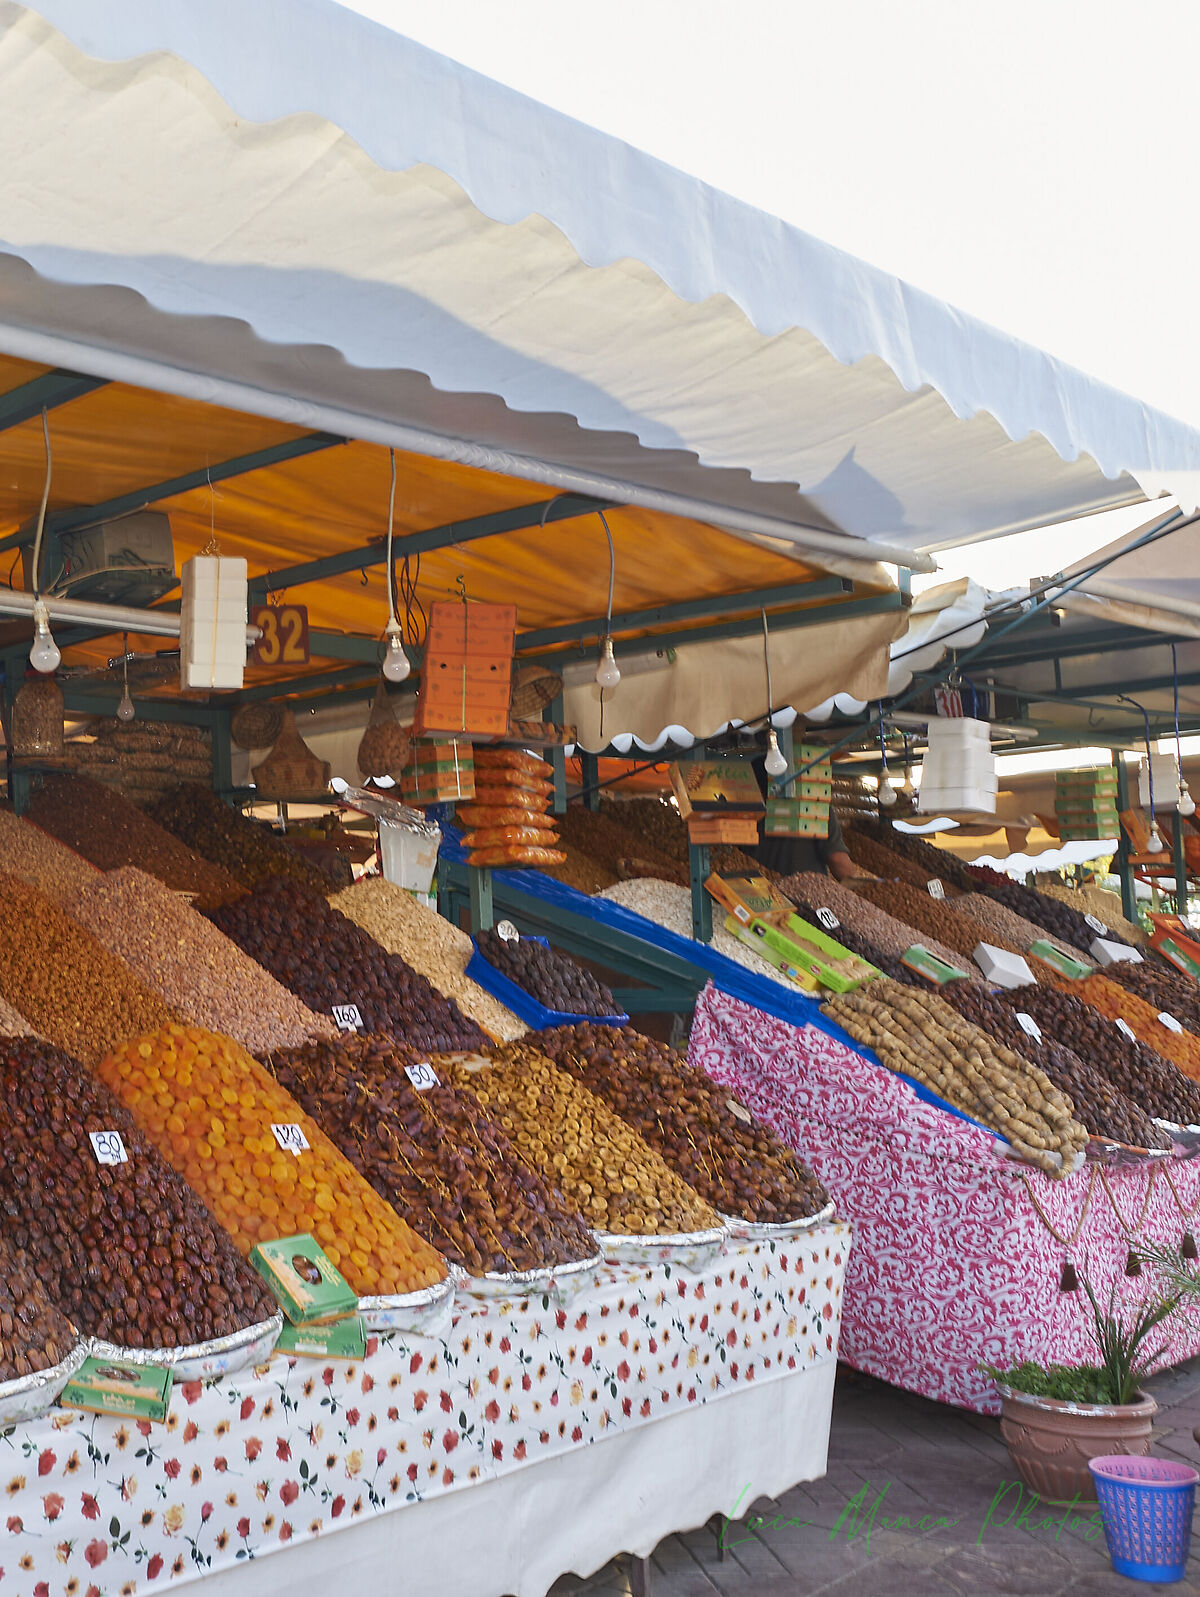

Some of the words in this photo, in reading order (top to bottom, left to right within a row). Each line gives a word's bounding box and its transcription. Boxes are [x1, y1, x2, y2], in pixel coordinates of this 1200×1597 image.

[257, 609, 306, 663] 32
[335, 1006, 357, 1024] 160
[409, 1064, 431, 1085] 50
[95, 1133, 121, 1155] 80
[275, 1124, 302, 1144] 120
